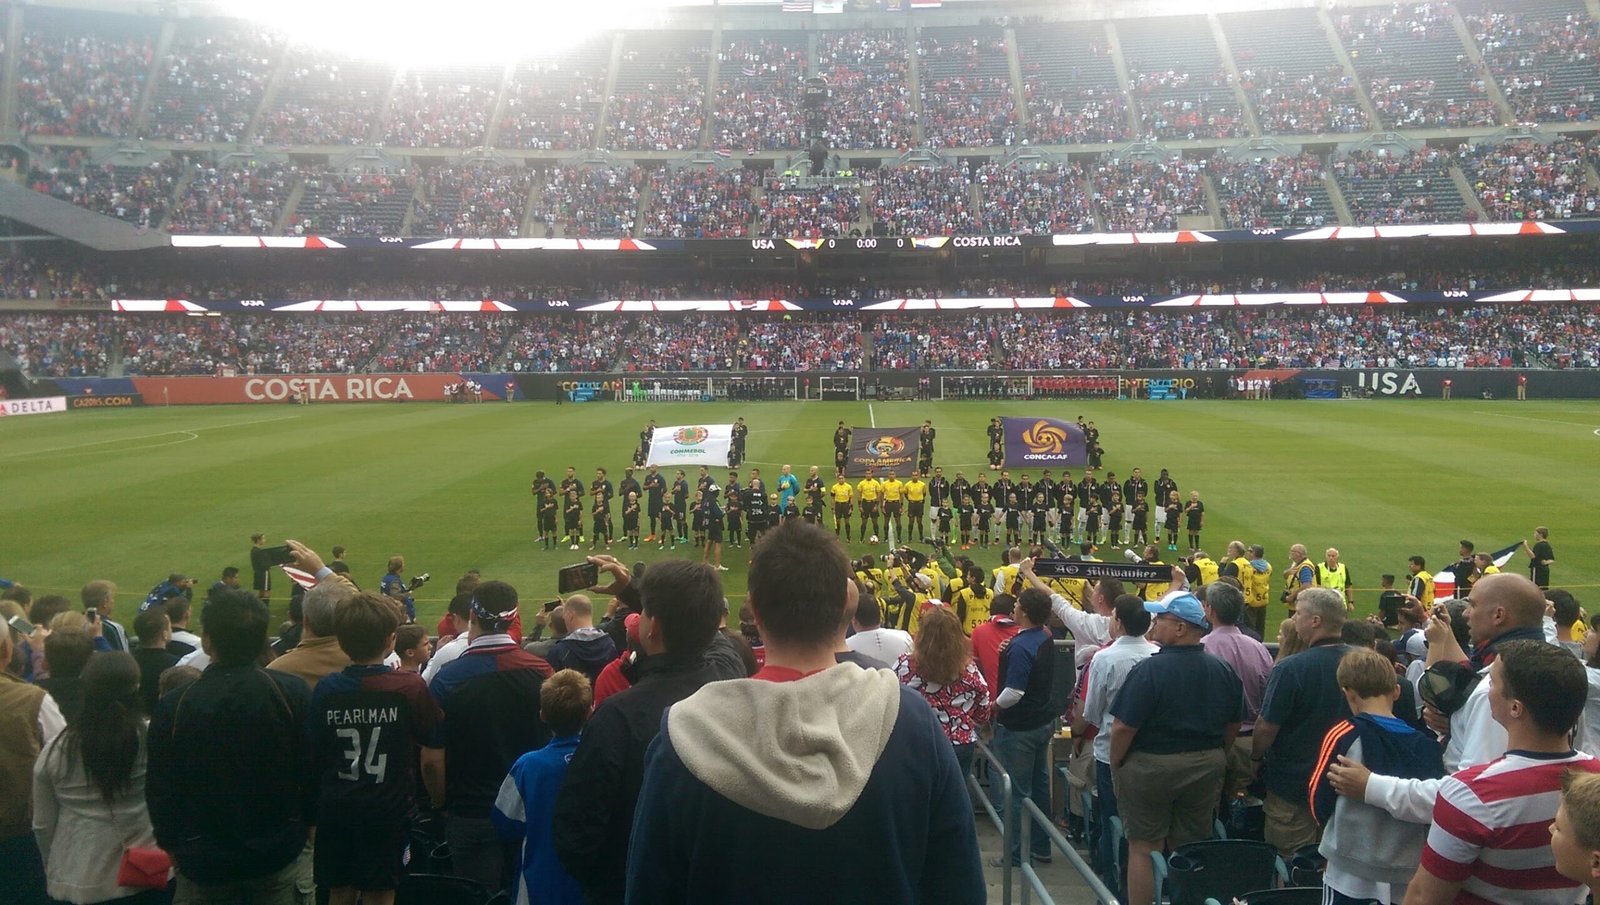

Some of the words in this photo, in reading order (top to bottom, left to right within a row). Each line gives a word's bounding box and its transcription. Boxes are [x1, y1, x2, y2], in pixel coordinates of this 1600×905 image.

[752, 239, 775, 249] USA
[828, 239, 835, 248] 0
[856, 239, 877, 248] 0:00
[896, 239, 904, 248] 0
[953, 237, 990, 247] COSTA
[993, 236, 1021, 246] RICA
[245, 378, 339, 400] COSTA
[347, 377, 413, 399] RICA
[1358, 372, 1422, 394] USA
[12, 400, 52, 413] DELTA
[327, 707, 398, 726] PEARLMAN
[336, 726, 387, 784] 34
